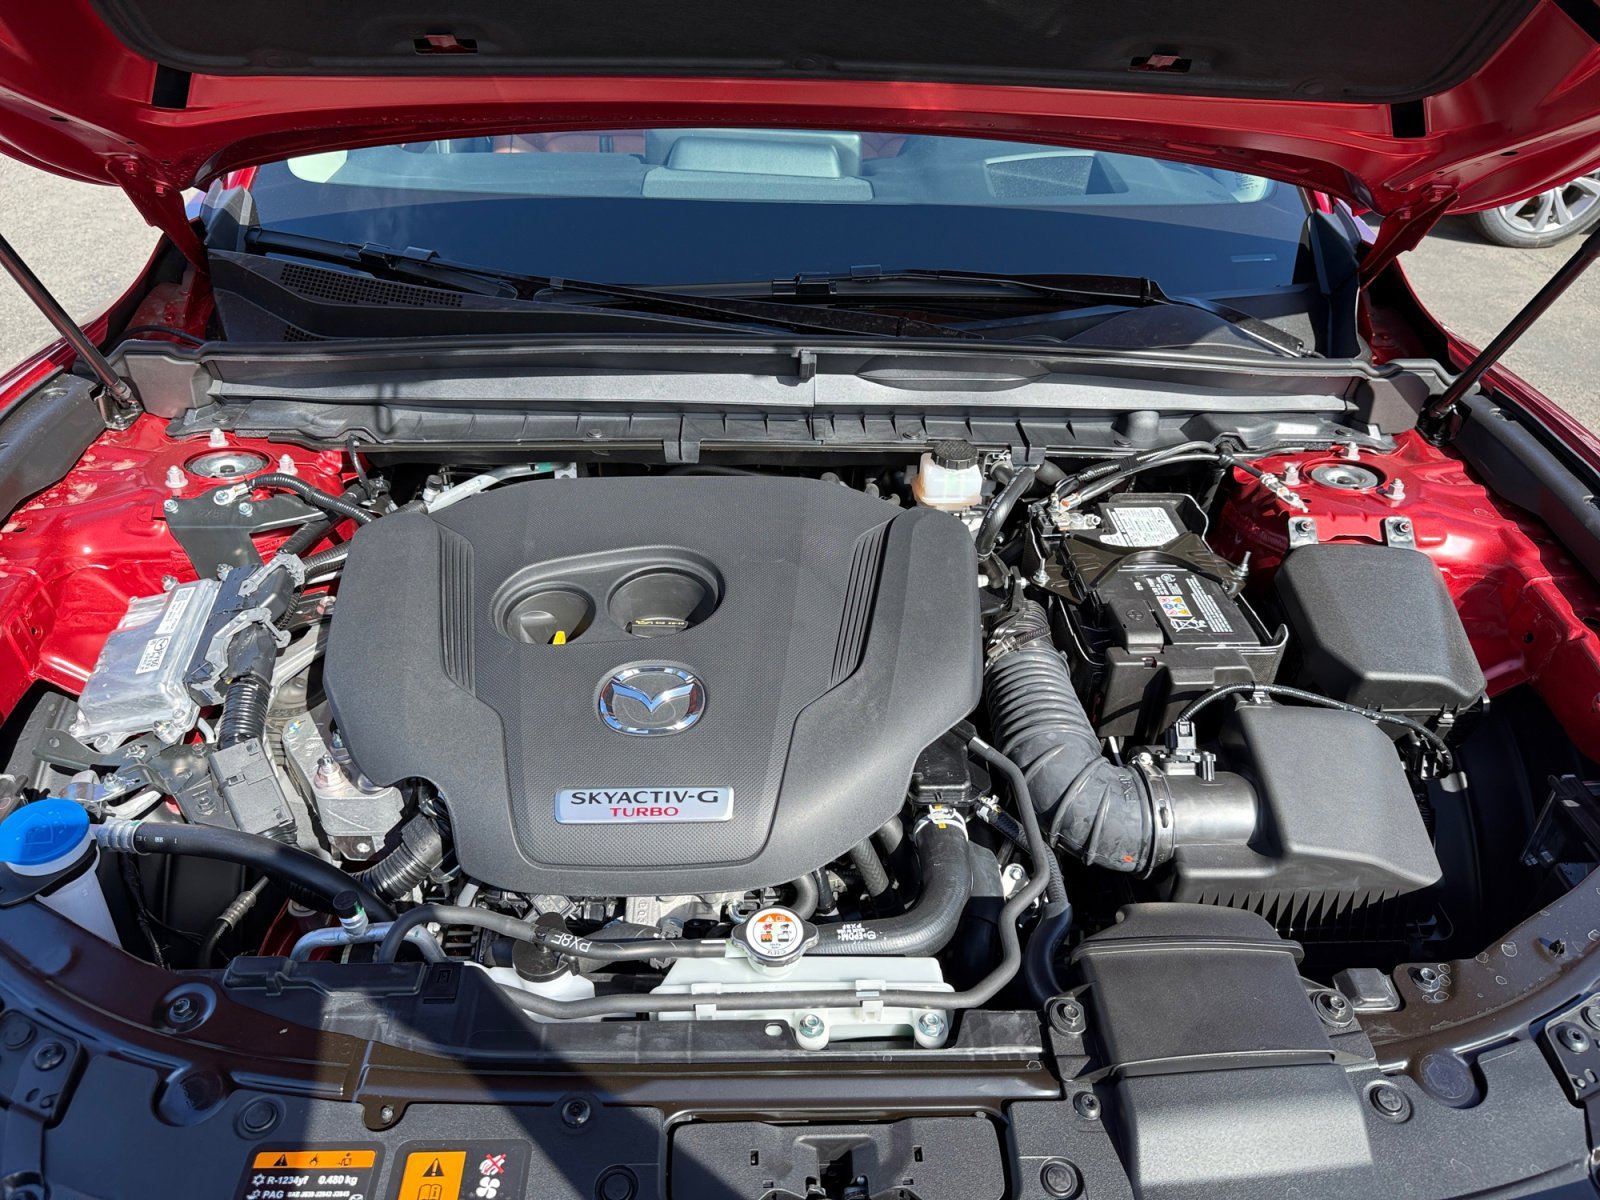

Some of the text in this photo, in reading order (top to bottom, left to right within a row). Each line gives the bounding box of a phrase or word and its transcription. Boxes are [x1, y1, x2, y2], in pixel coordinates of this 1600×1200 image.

[570, 790, 719, 805] SKYACTIV-G
[609, 806, 679, 817] TURBO
[550, 932, 593, 953] PX8F
[266, 1175, 310, 1187] R-1234yf
[344, 1175, 359, 1186] kg
[262, 1190, 285, 1199] PAG
